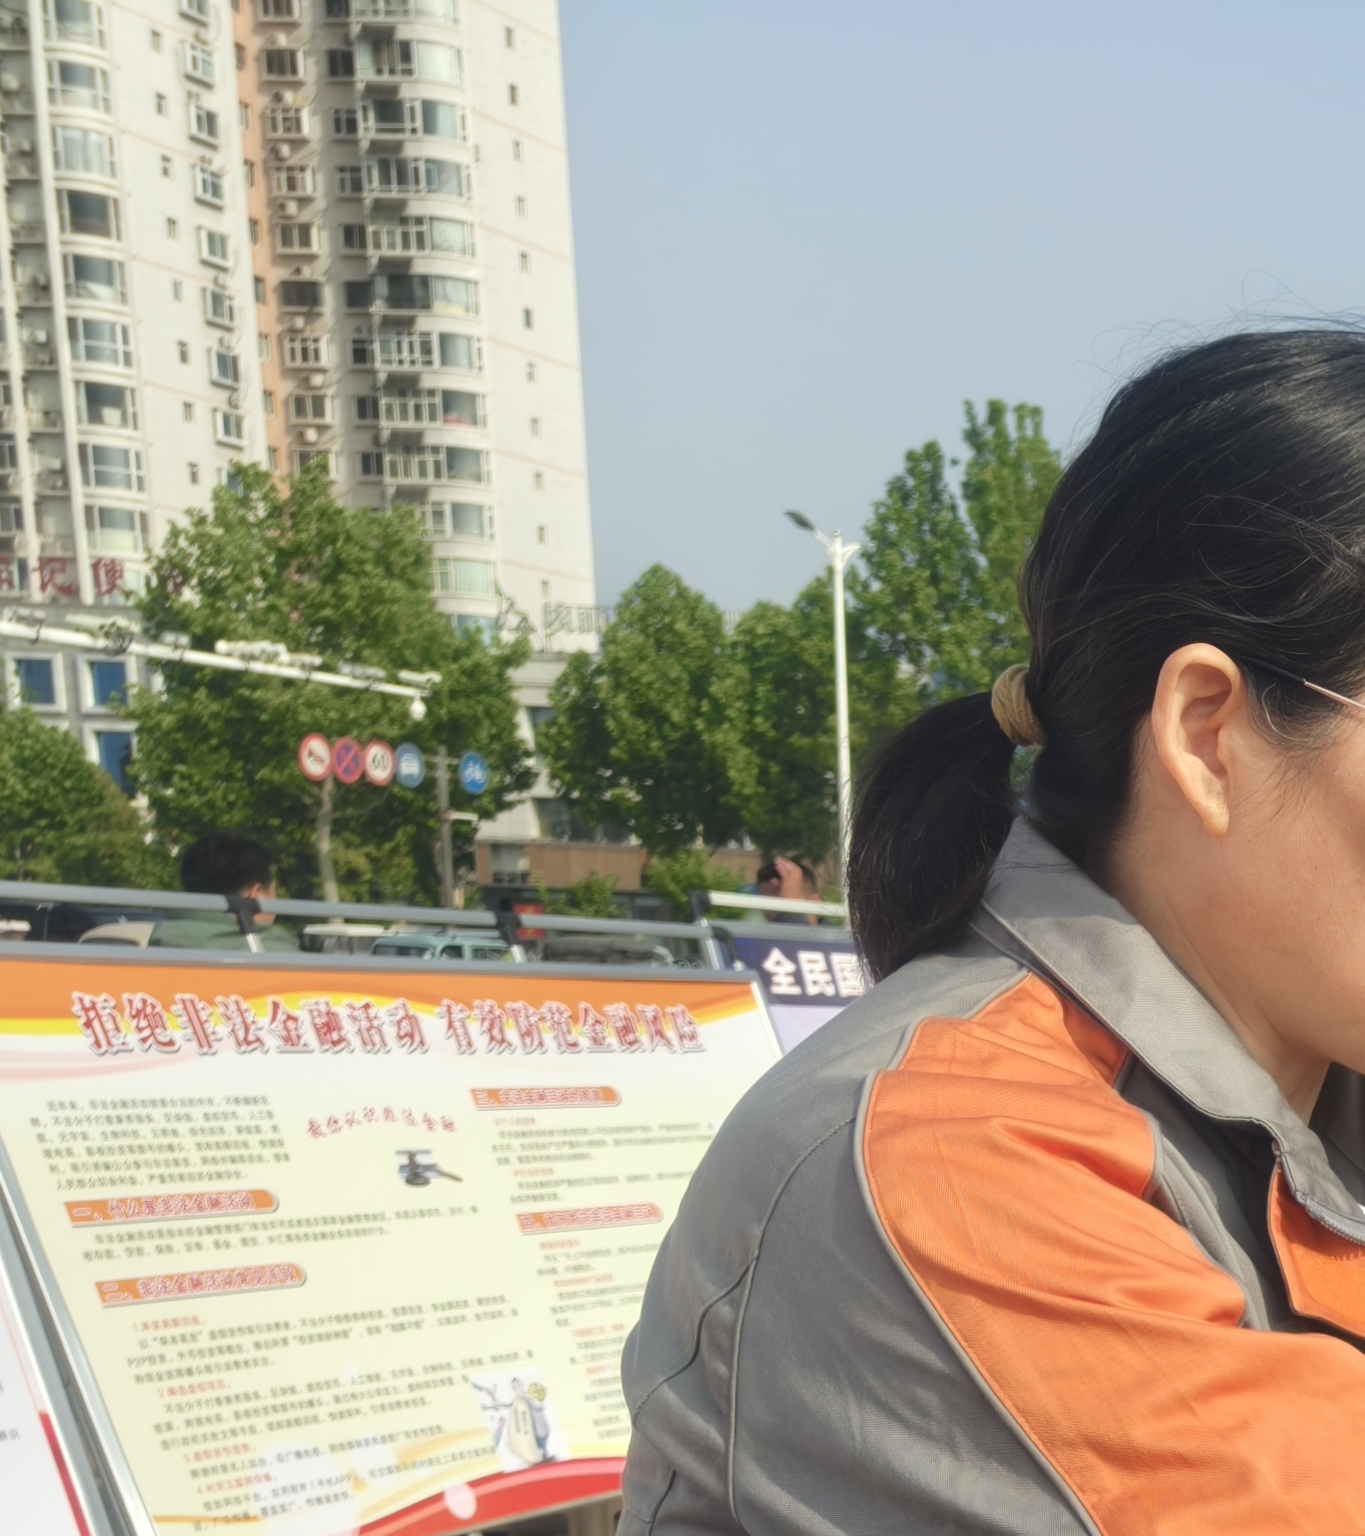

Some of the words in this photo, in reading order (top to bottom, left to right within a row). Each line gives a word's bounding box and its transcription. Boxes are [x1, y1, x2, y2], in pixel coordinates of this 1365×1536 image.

[71, 991, 430, 1054] 拒绝非法金融活动
[435, 997, 706, 1055] 有效防范金融风险
